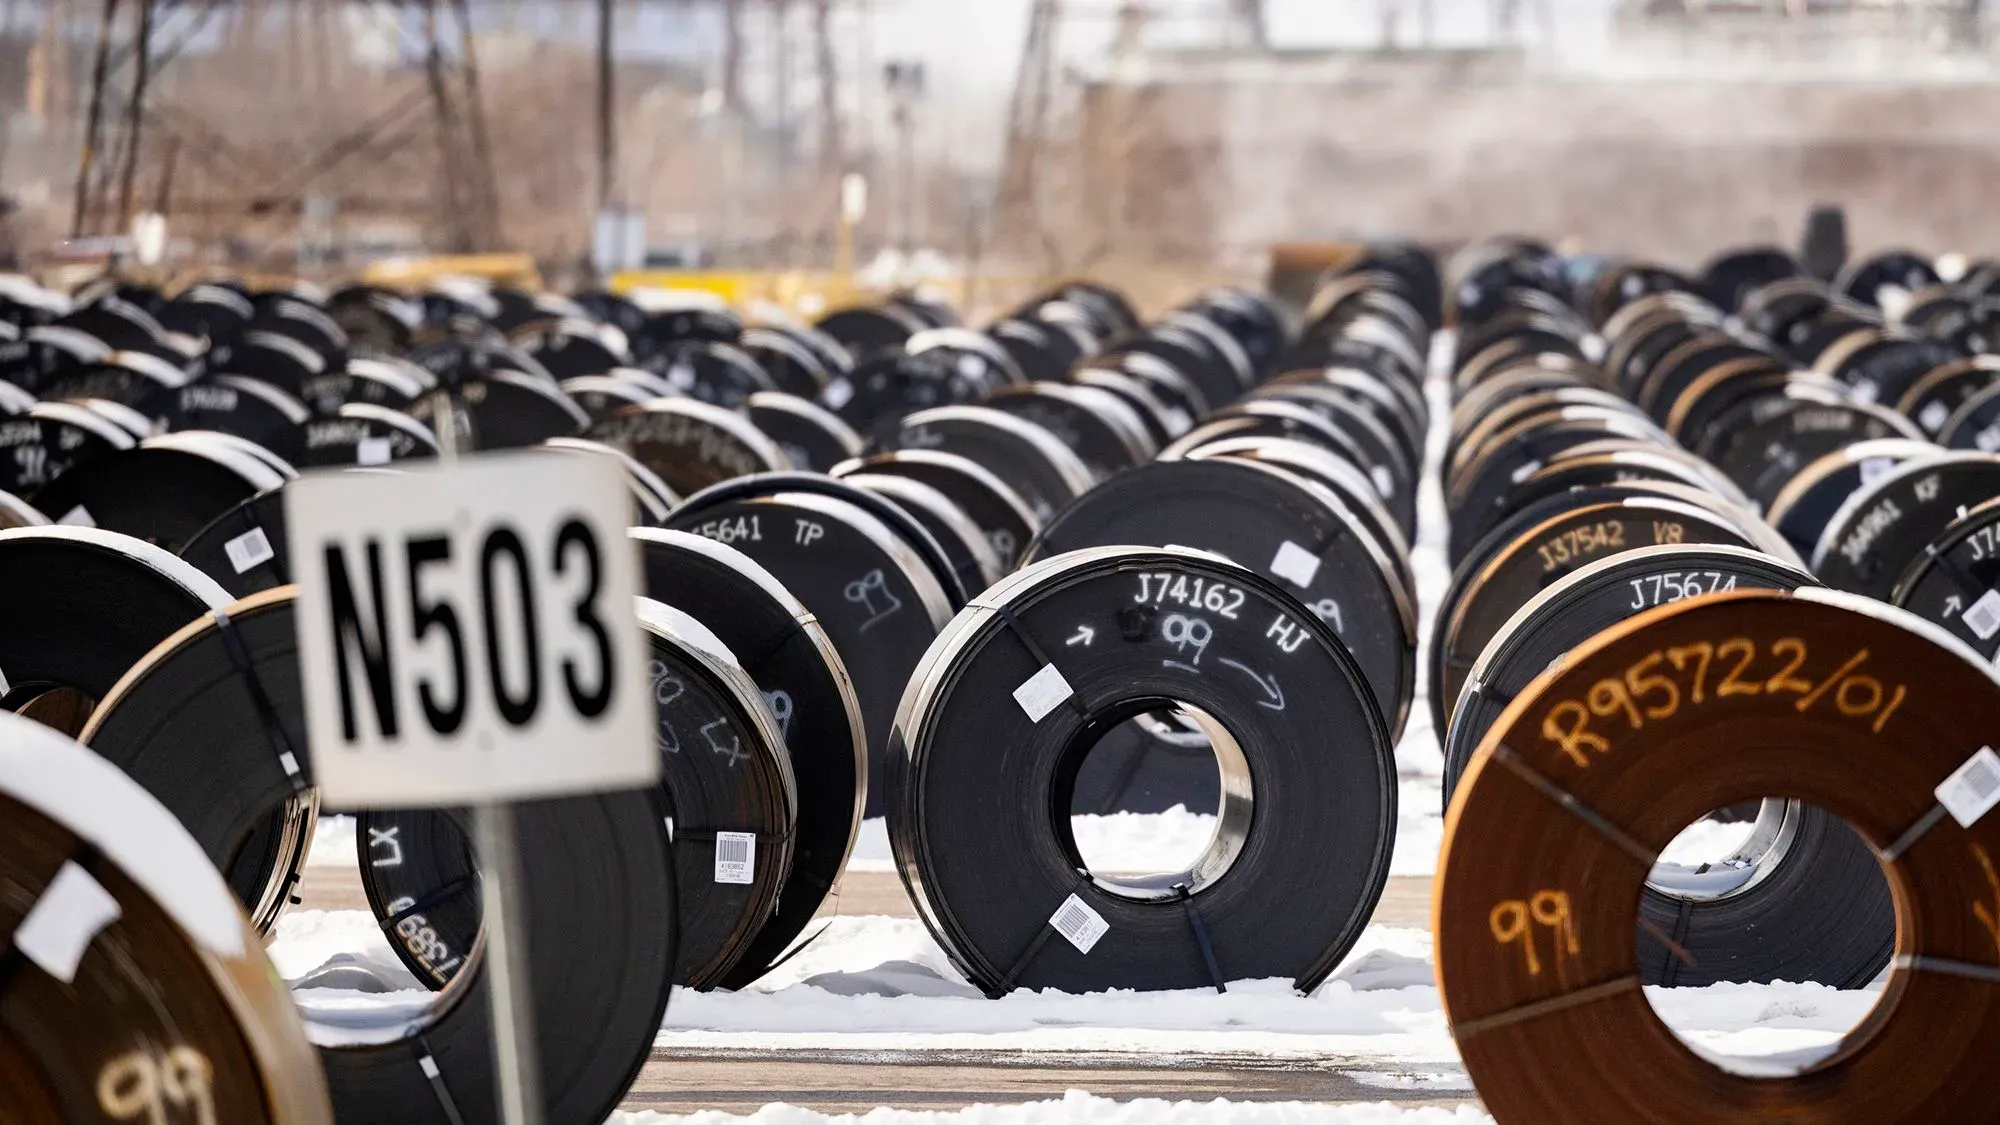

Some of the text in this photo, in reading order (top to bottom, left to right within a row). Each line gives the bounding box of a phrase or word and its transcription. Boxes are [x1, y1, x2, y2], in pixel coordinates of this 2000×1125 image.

[691, 514, 824, 547] 5641 TP
[1537, 520, 1684, 572] J37542 V8
[1966, 522, 2000, 561] J7
[324, 520, 615, 742] N503
[1134, 573, 1311, 653] J74162 HJ
[1162, 614, 1213, 665] 99
[1542, 637, 1909, 769] R95722/01
[369, 826, 403, 868] LX
[1489, 889, 1580, 976] 99
[97, 1044, 217, 1125] 99
